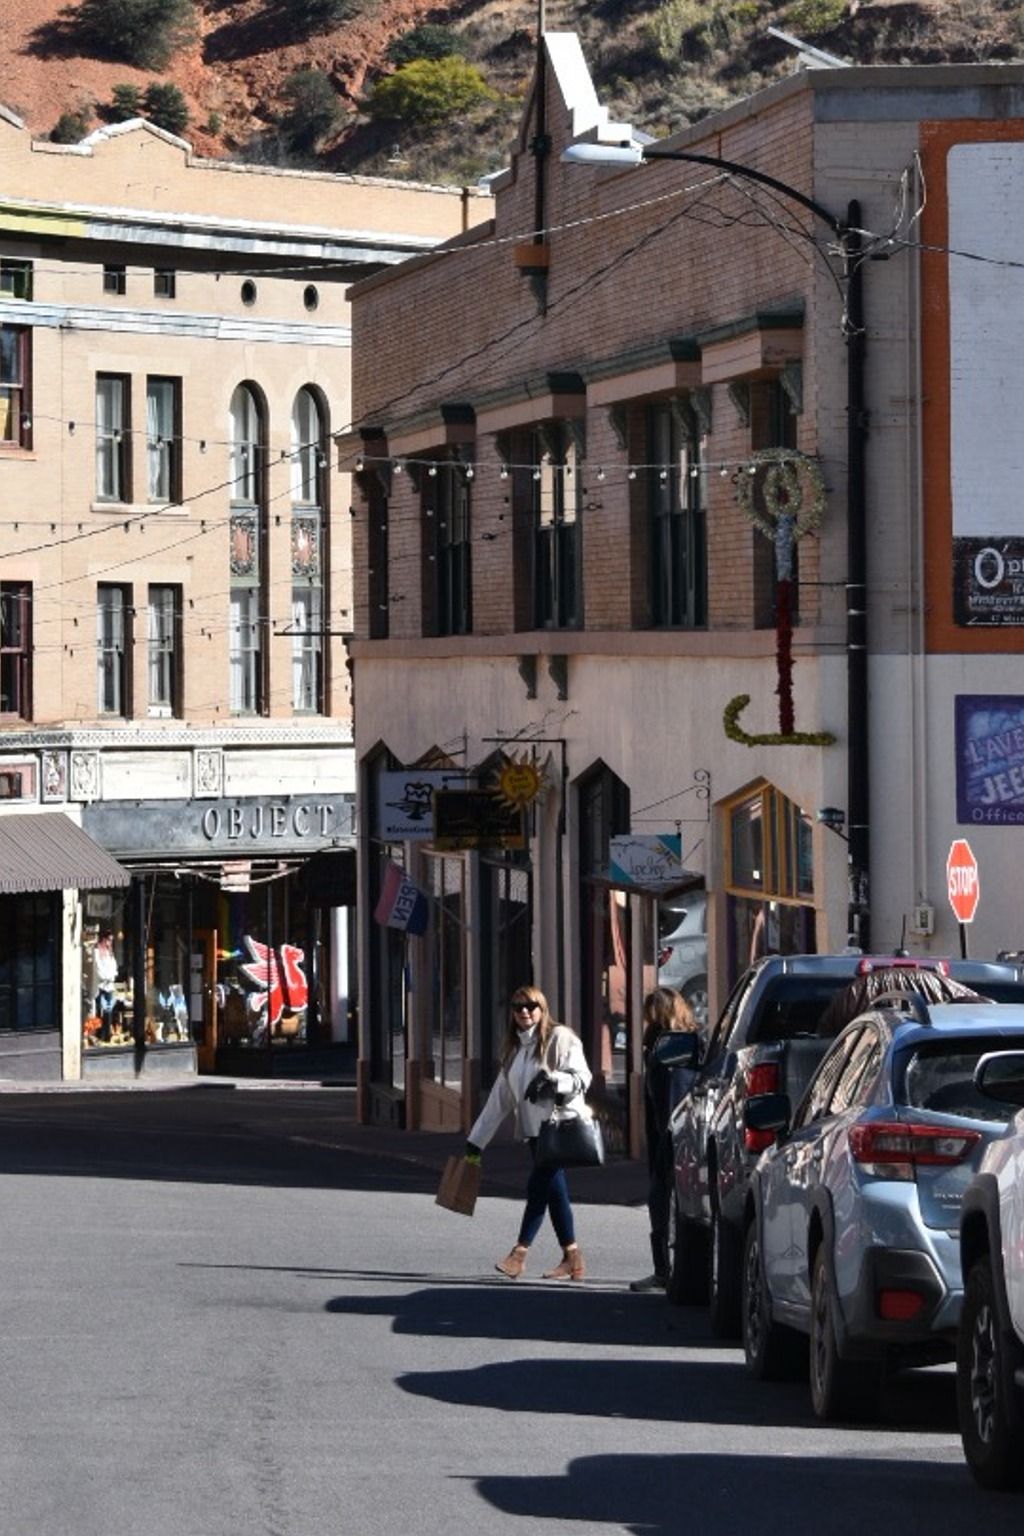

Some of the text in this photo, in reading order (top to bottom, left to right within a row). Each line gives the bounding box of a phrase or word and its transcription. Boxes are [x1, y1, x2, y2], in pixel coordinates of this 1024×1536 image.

[979, 766, 1024, 804] JEE
[202, 805, 334, 840] OBJECT
[949, 866, 977, 896] STOP
